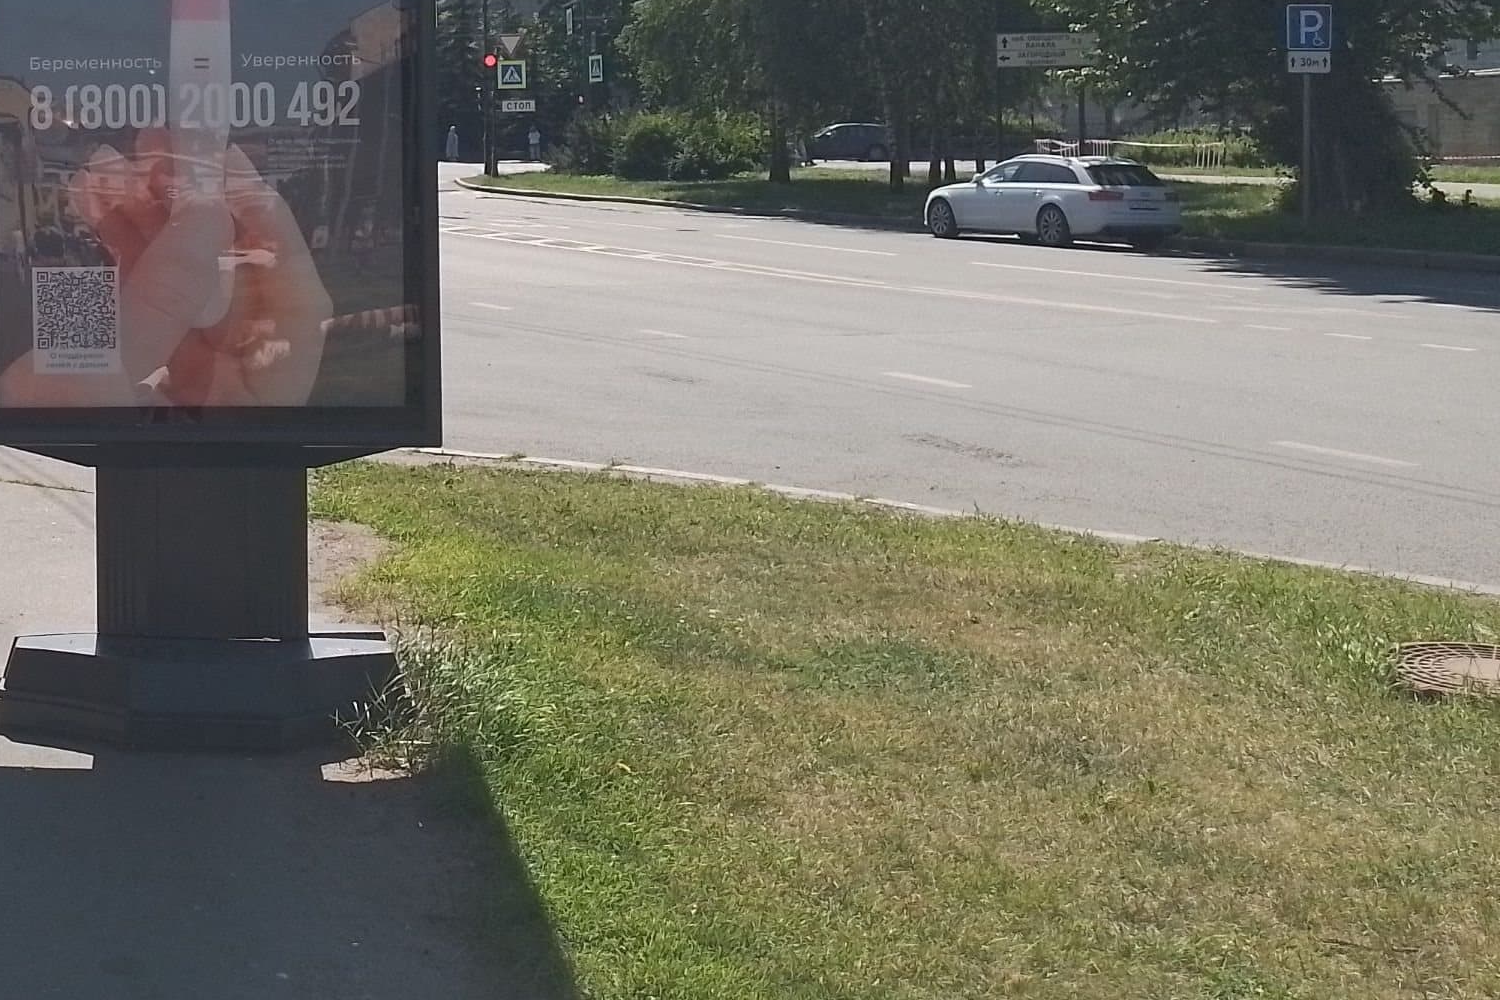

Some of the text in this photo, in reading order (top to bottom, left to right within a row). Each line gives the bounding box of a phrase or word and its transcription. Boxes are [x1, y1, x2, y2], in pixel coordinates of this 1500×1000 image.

[1300, 10, 1323, 44] P
[29, 57, 162, 72] Беременность
[241, 53, 362, 69] Уверенность
[31, 80, 361, 130] 8 (800) 2000 492
[507, 102, 531, 110] СТОП
